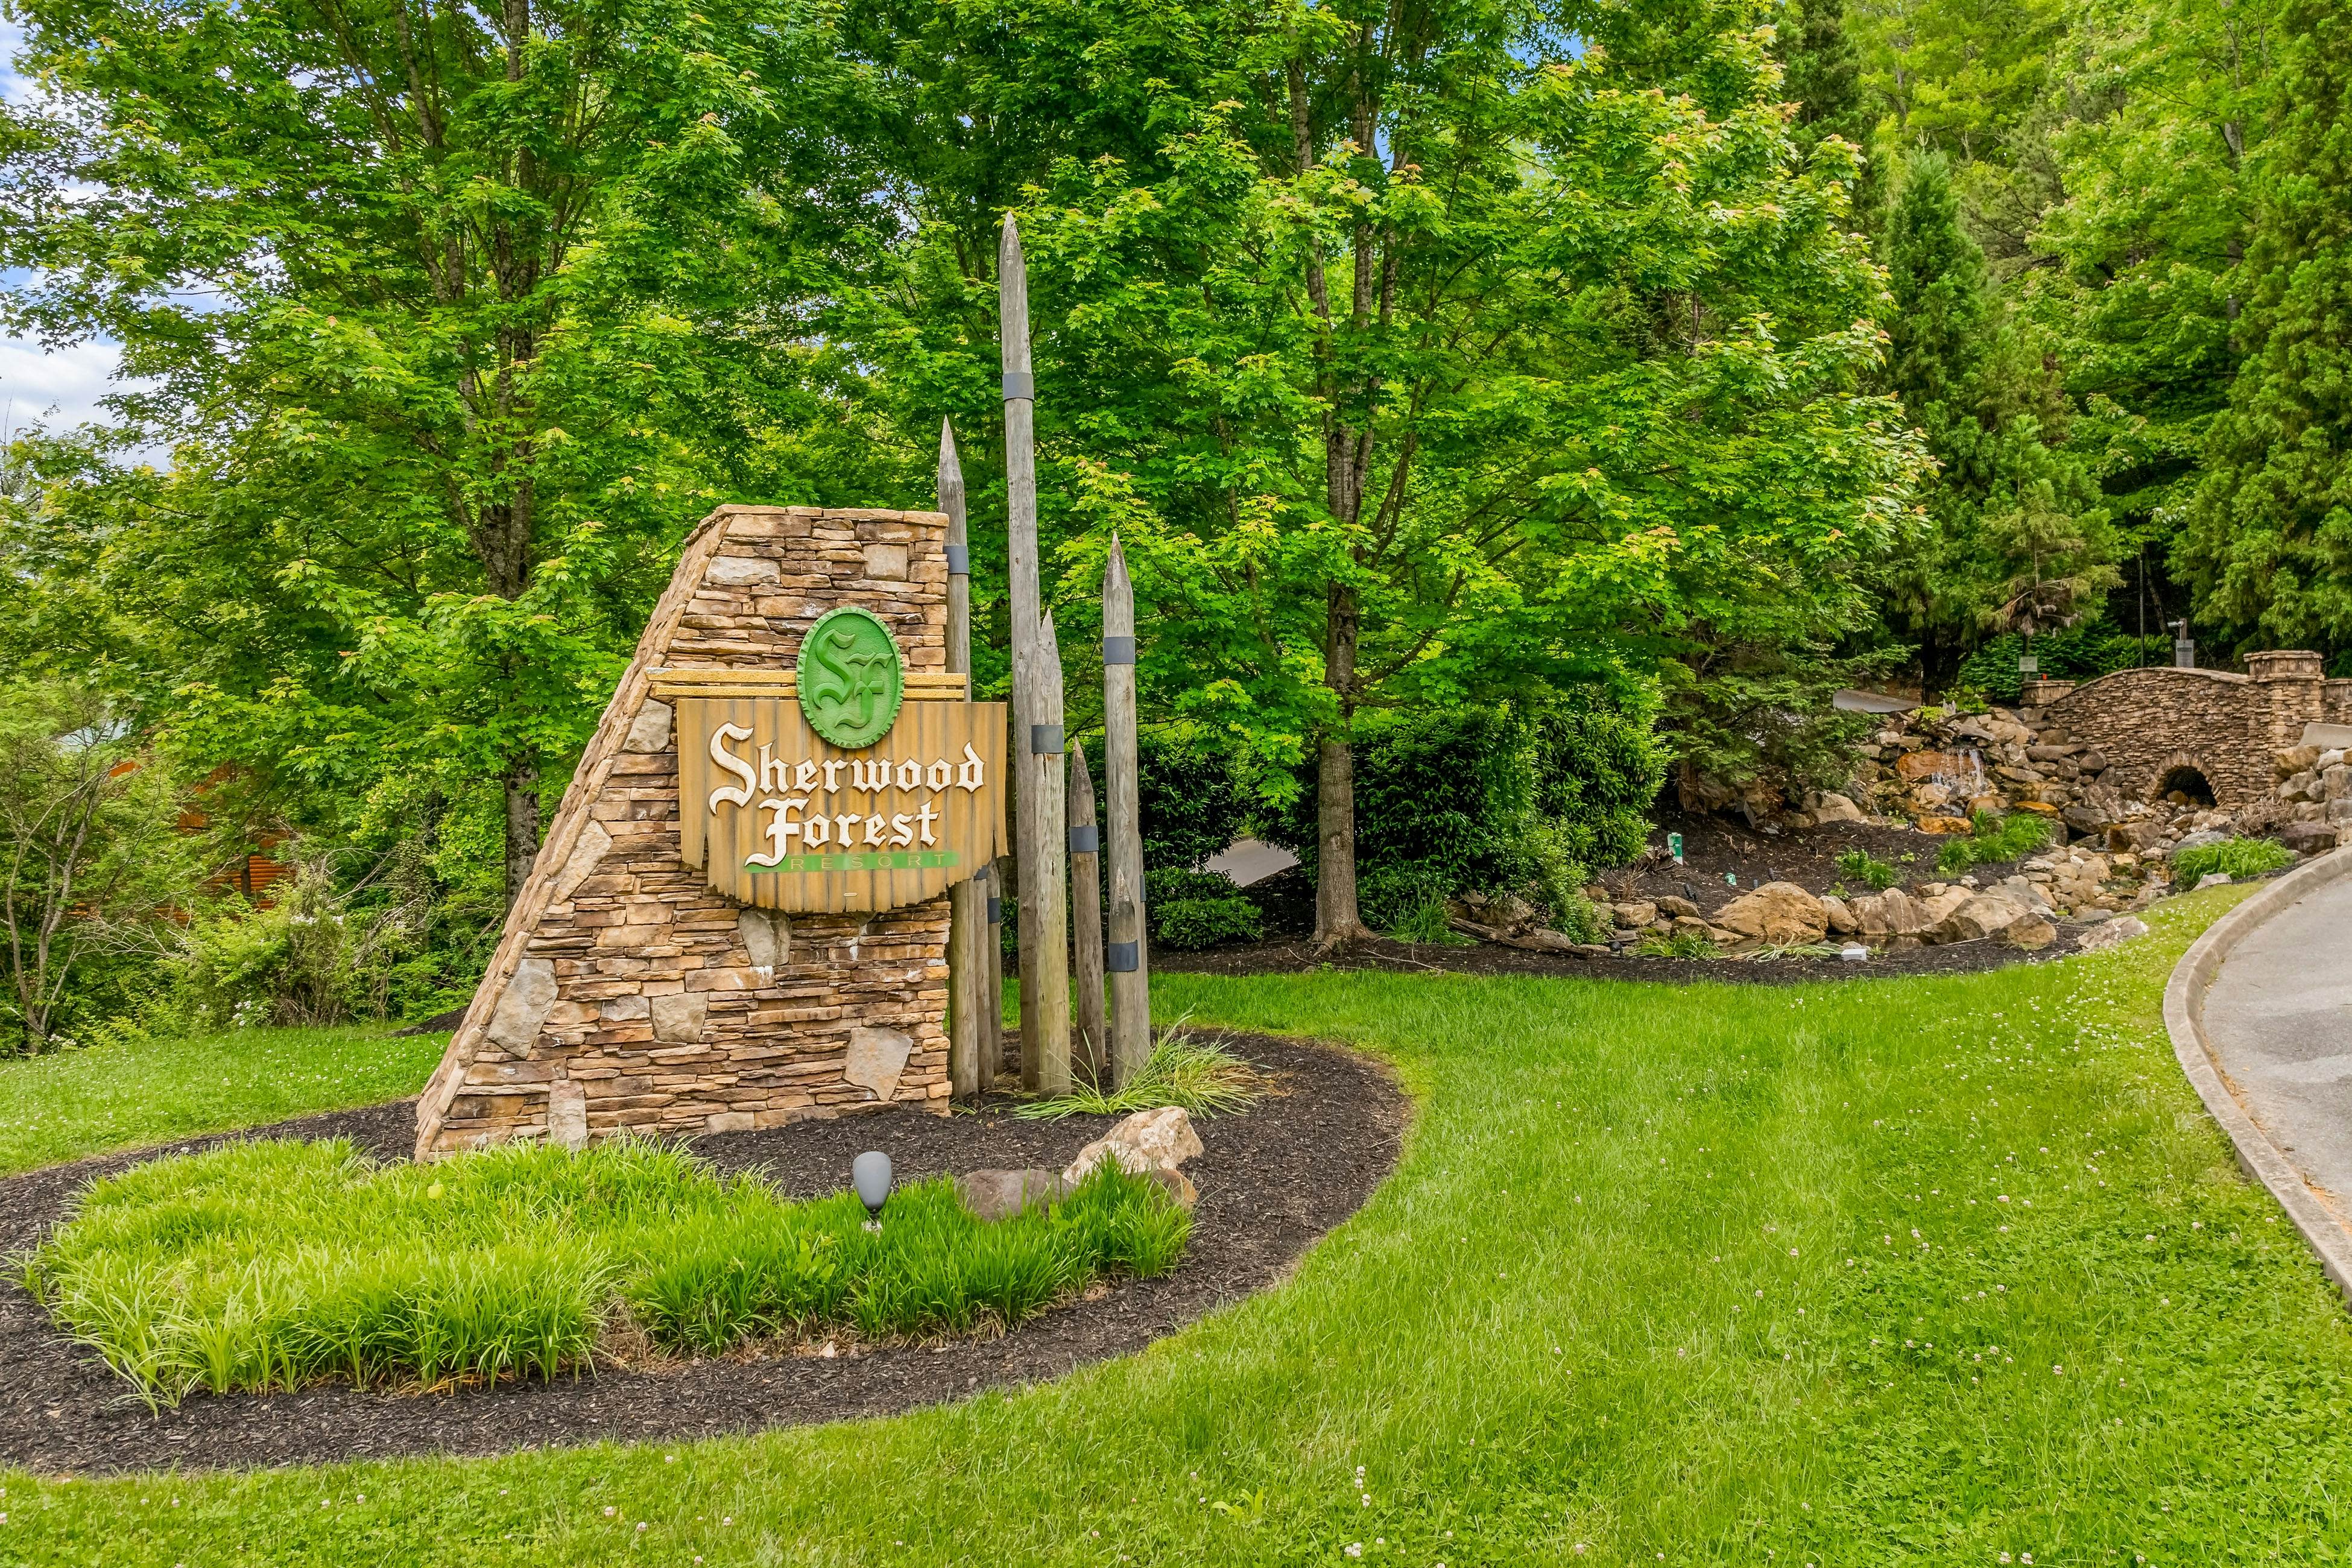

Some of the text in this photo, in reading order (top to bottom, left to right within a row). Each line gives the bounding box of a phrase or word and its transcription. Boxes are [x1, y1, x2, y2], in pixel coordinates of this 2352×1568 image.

[709, 721, 985, 816] Sherwood
[744, 797, 941, 867] Forest
[791, 854, 944, 870] RESORT
